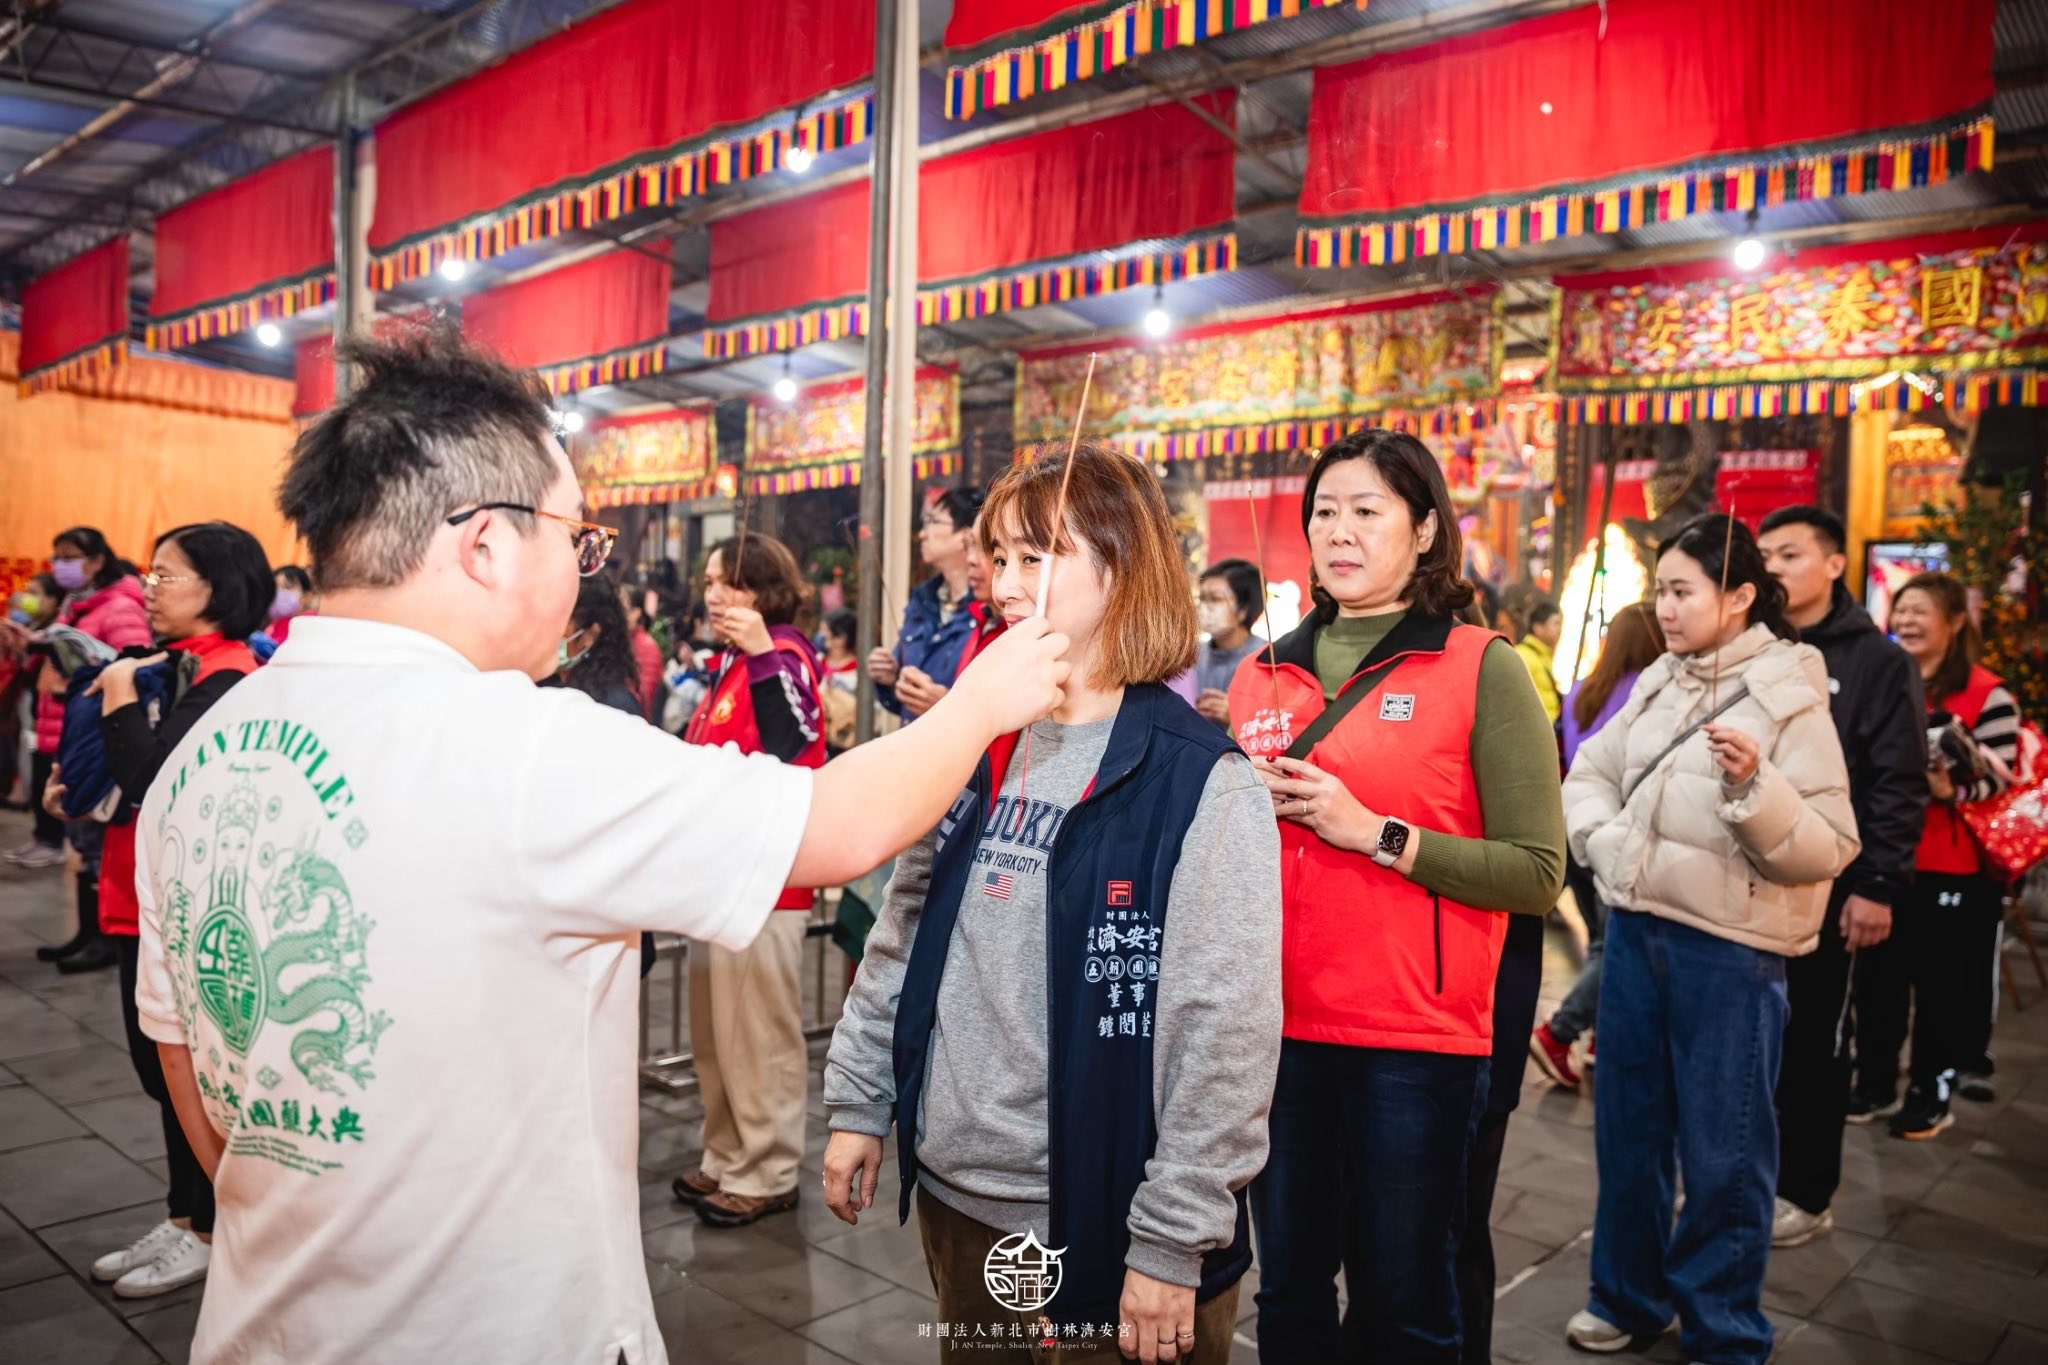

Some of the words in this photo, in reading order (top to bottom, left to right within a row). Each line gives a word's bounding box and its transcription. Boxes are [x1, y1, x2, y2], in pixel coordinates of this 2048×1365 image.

[190, 724, 233, 777] AN
[238, 718, 355, 821] TEMPLE
[973, 848, 995, 864] NEW
[993, 852, 1019, 870] YORK
[1018, 857, 1041, 876] CITY
[1106, 910, 1150, 921] 財團法人
[1098, 922, 1162, 952] 濟安宮
[1108, 982, 1147, 1008] 董事
